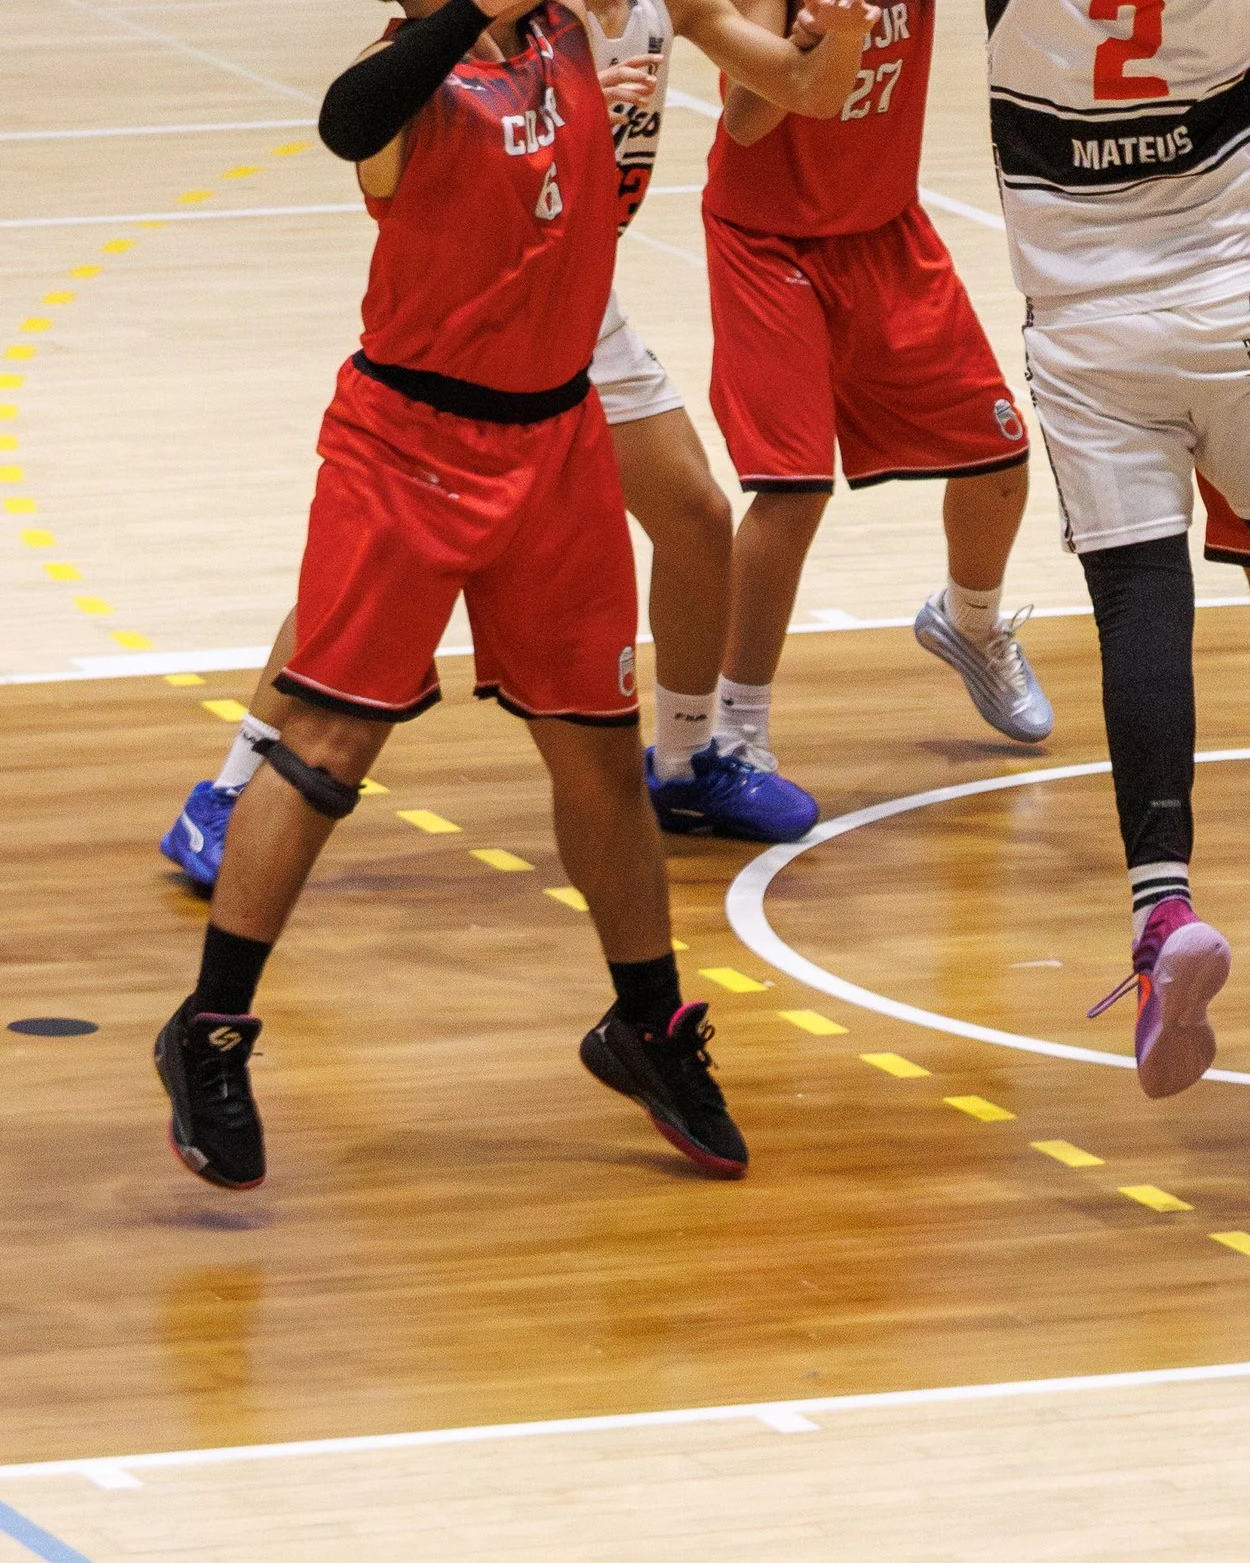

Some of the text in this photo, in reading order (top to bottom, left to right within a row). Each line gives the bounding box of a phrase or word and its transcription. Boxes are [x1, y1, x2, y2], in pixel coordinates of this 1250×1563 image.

[841, 59, 904, 123] 27
[1072, 125, 1194, 170] MATEUS
[534, 161, 564, 221] 6
